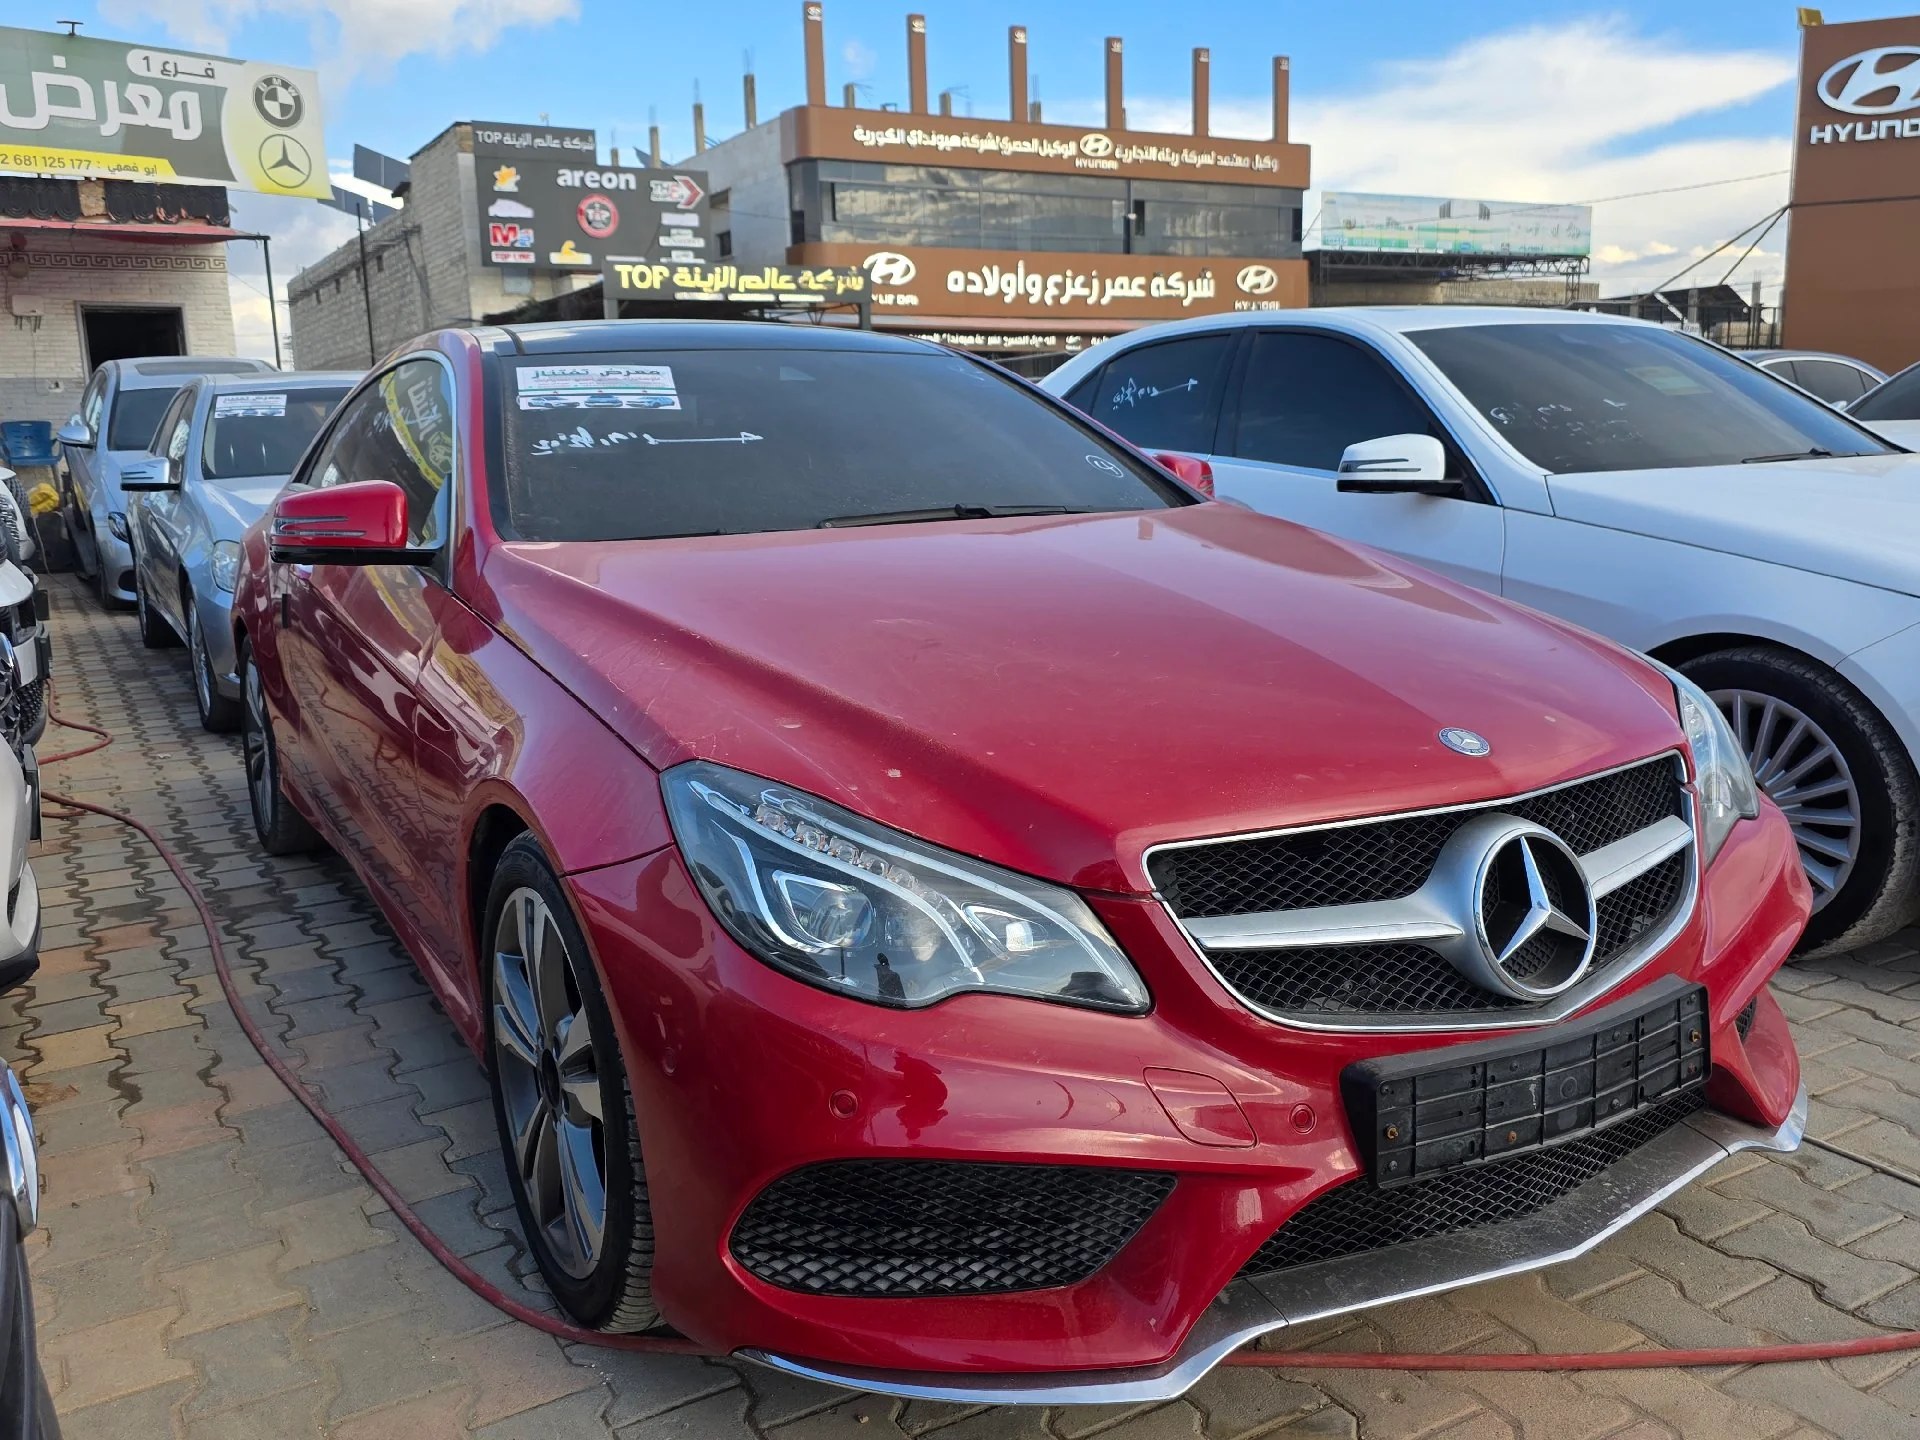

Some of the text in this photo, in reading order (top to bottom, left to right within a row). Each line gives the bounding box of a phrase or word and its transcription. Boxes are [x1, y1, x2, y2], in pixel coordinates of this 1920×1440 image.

[0, 54, 204, 141] معرض
[258, 76, 300, 97] BMW
[475, 130, 502, 145] TOP
[853, 124, 905, 146] الكورية
[13, 154, 38, 167] 681
[42, 156, 66, 169] 125
[70, 158, 92, 170] 177
[1075, 157, 1119, 171] HYUNDAI
[556, 168, 637, 190] areon
[614, 264, 865, 294] شركة عالم الزينة TOP
[1150, 268, 1216, 308] شركة
[1100, 275, 1147, 306] عمر
